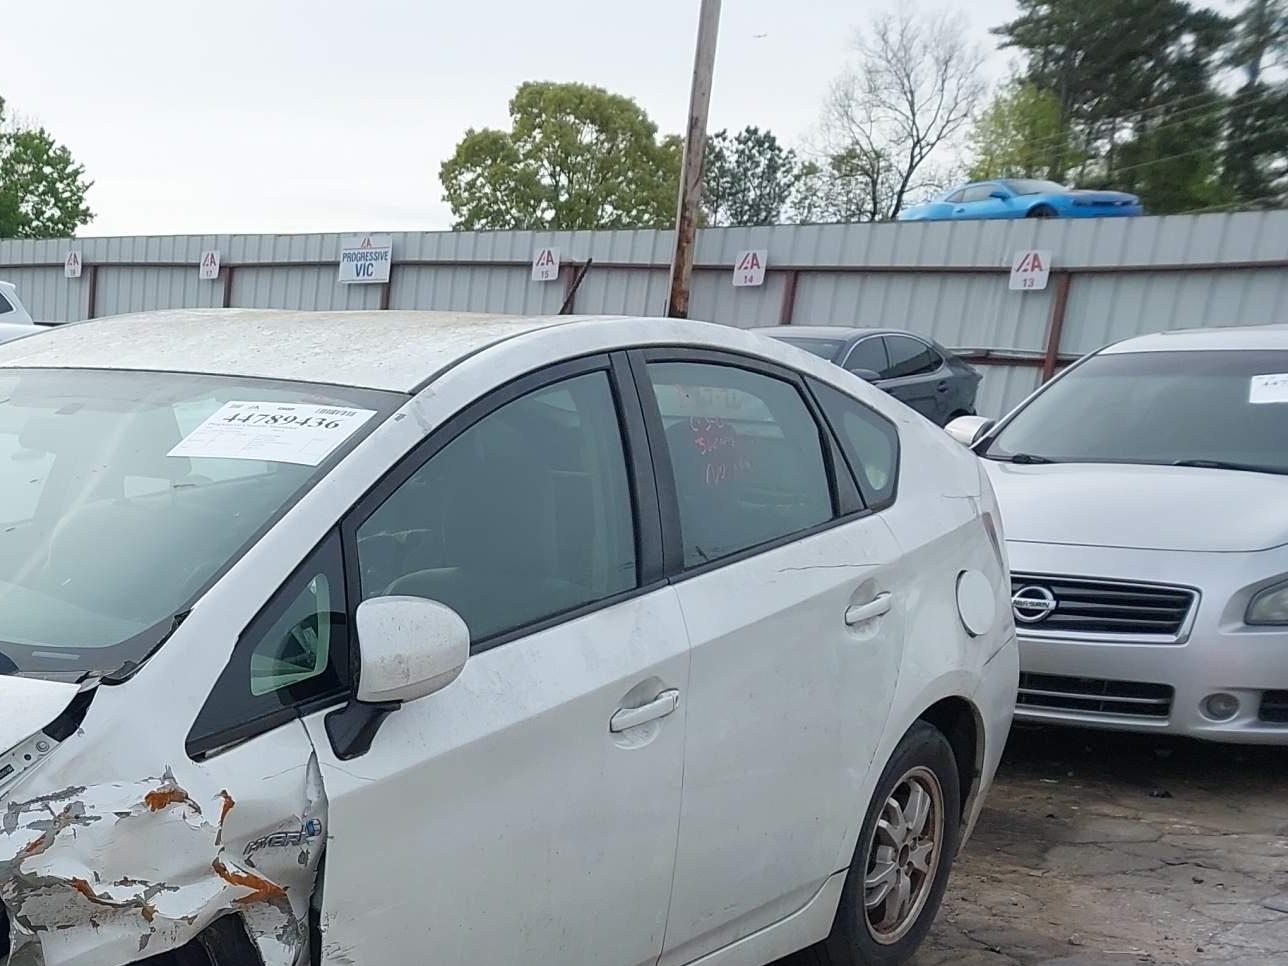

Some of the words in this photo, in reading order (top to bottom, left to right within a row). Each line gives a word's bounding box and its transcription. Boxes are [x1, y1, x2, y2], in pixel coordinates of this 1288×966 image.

[342, 250, 389, 262] PROGRESSIVE
[355, 262, 374, 277] VIC
[744, 275, 754, 284] 14
[1023, 278, 1035, 288] 13
[223, 411, 346, 431] 44789436
